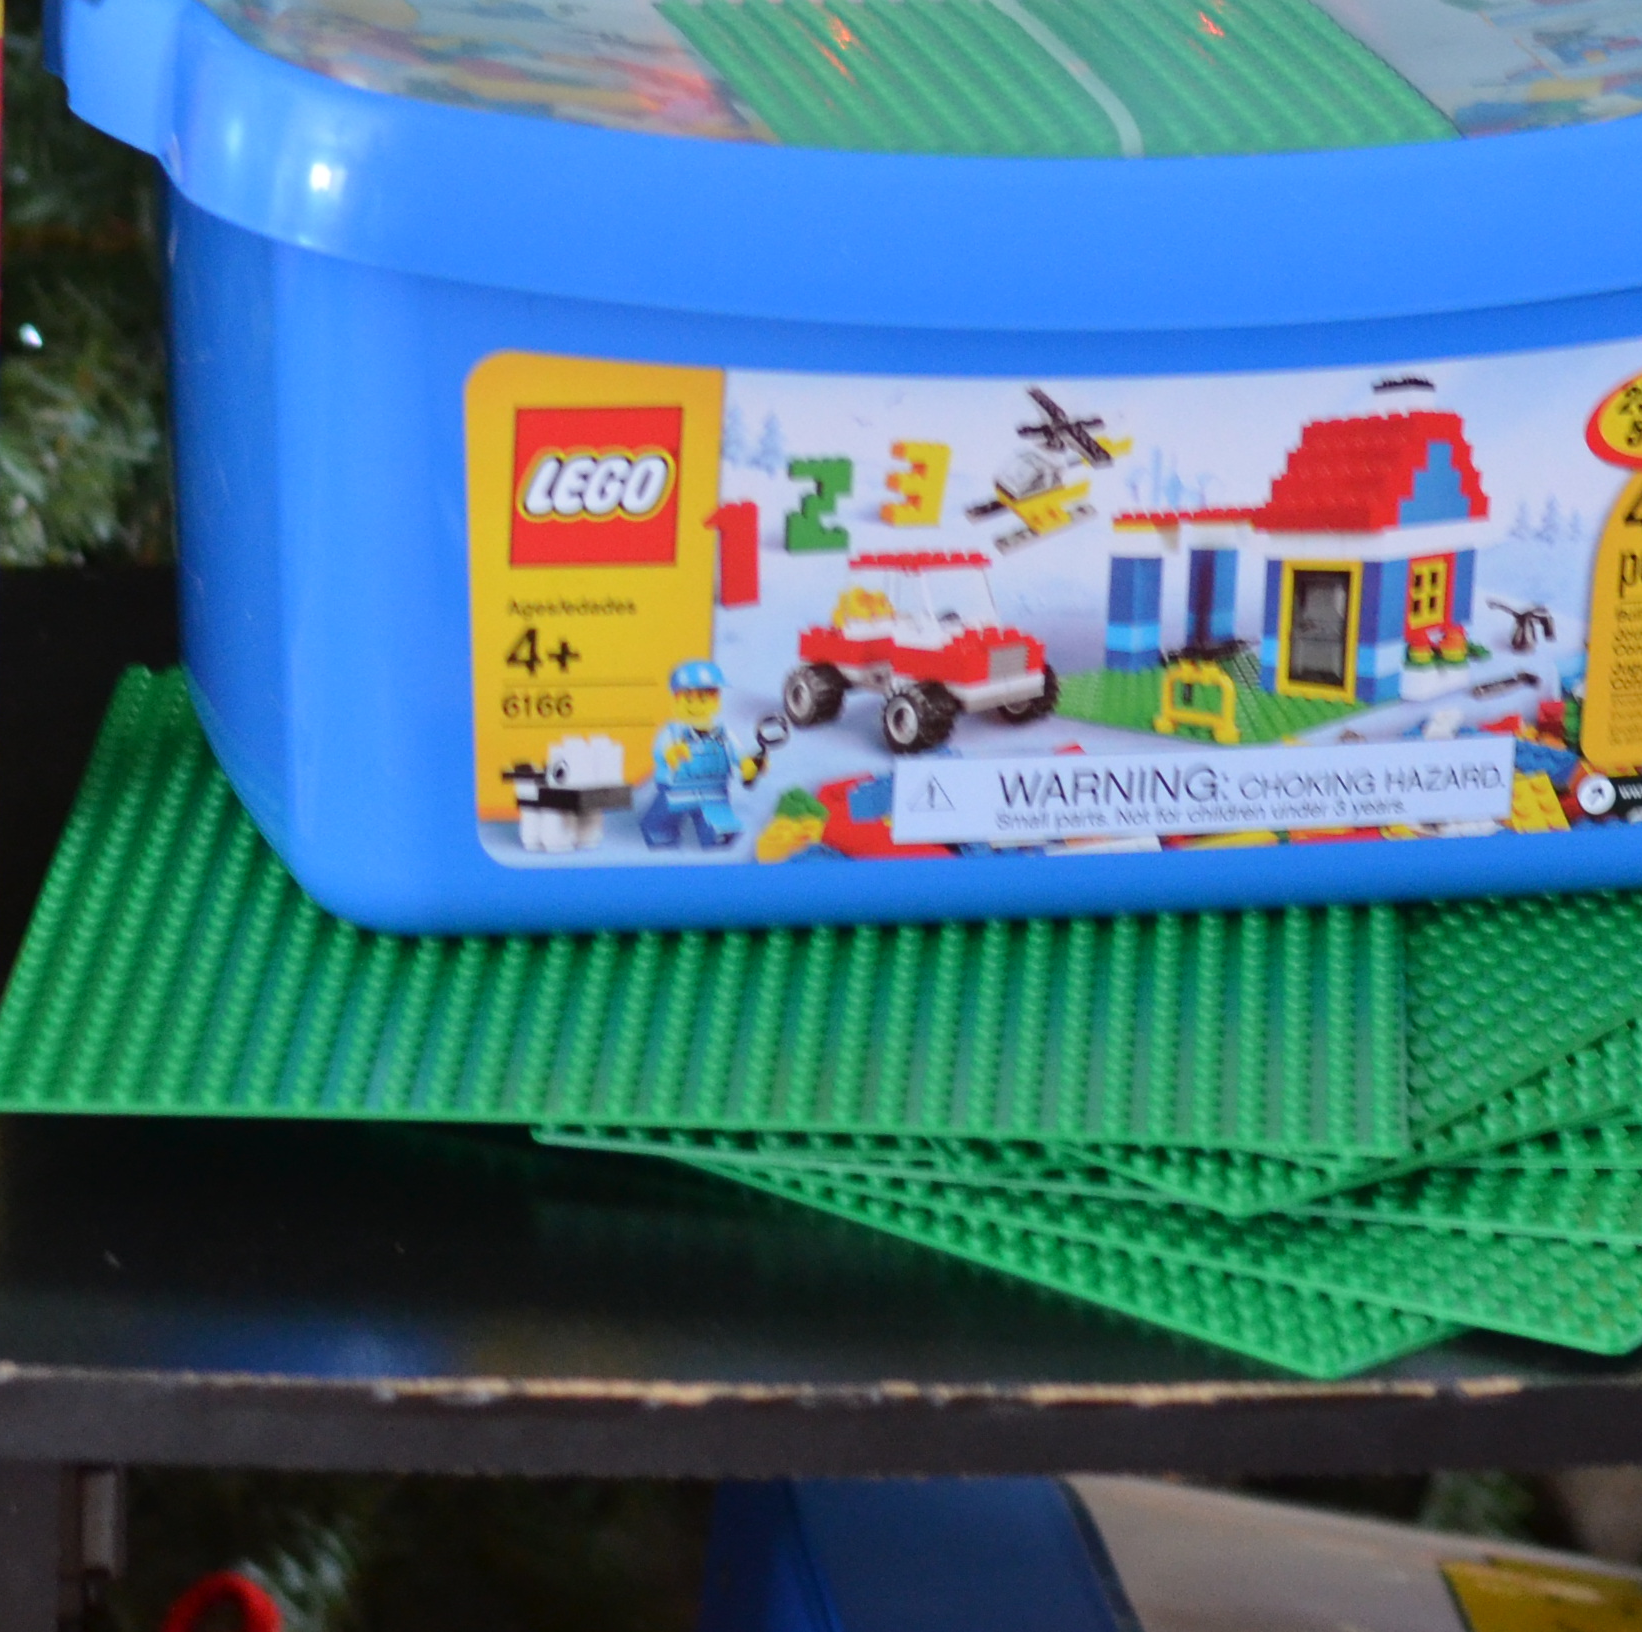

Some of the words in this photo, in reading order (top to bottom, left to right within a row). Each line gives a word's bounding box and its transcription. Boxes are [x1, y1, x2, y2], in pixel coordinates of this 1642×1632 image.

[520, 451, 670, 519] LEGO
[509, 598, 637, 621] Ages/edades
[505, 626, 582, 677] 4+
[502, 692, 574, 719] 6166
[997, 765, 1233, 808] WARNING:
[1238, 768, 1377, 800] CHOKING
[1384, 764, 1507, 795] HAZARD.
[994, 810, 1050, 832] Small
[1116, 806, 1152, 826] Not
[1156, 804, 1183, 824] for
[1188, 801, 1269, 824] children
[1272, 798, 1328, 821] under
[1333, 799, 1347, 819] 3
